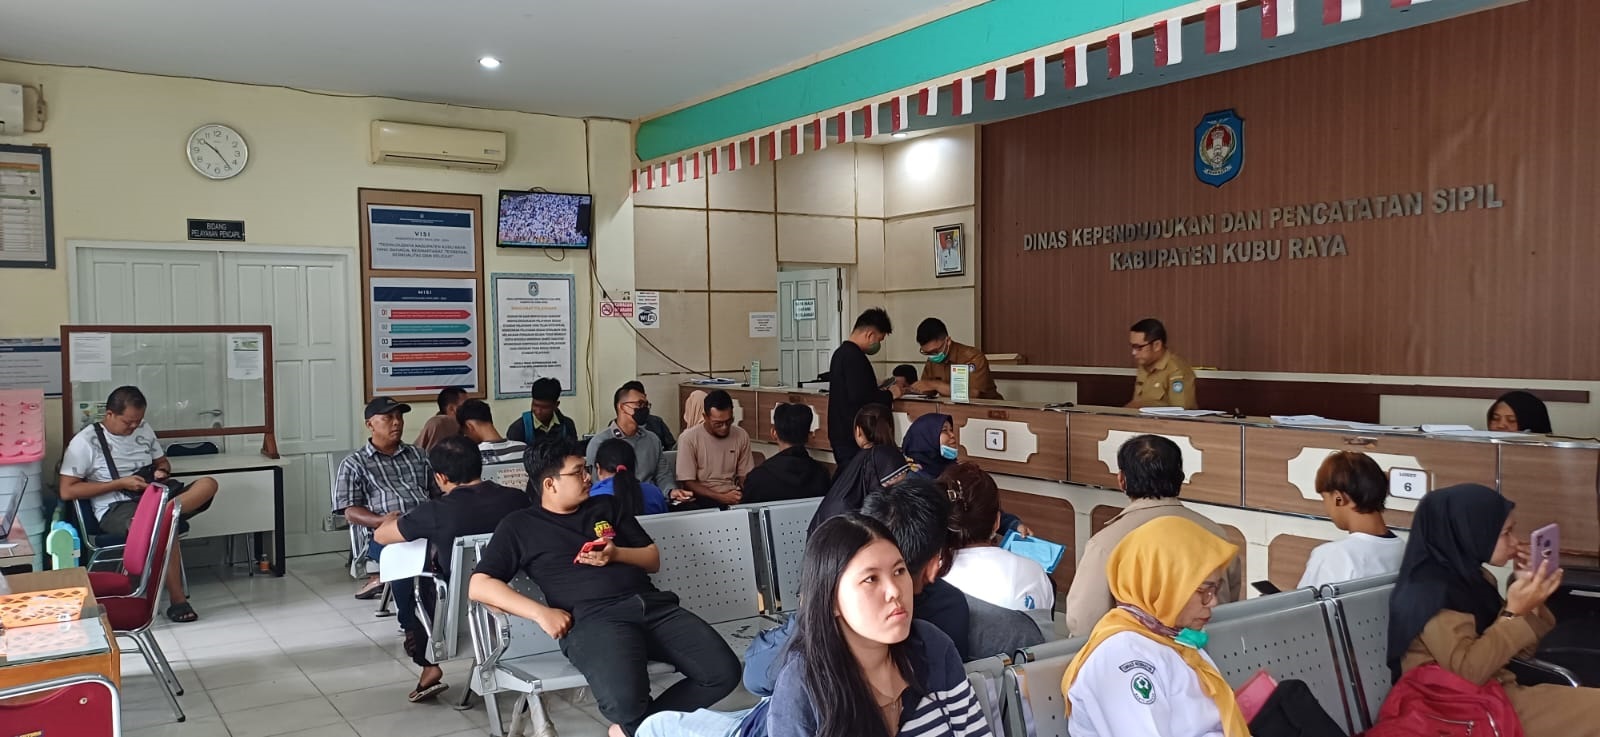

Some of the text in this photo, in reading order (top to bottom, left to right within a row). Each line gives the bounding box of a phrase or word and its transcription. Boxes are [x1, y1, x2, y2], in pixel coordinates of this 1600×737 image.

[1023, 183, 1503, 251] DINAS KEPENDUDUKAN DAN PENCATATAN SIPIL
[206, 222, 227, 230] BIDANG
[191, 230, 218, 238] PELAYANAN
[1110, 234, 1348, 271] KABUPATEN KUBU RAYA
[992, 437, 997, 445] 4
[1404, 482, 1412, 492] 6
